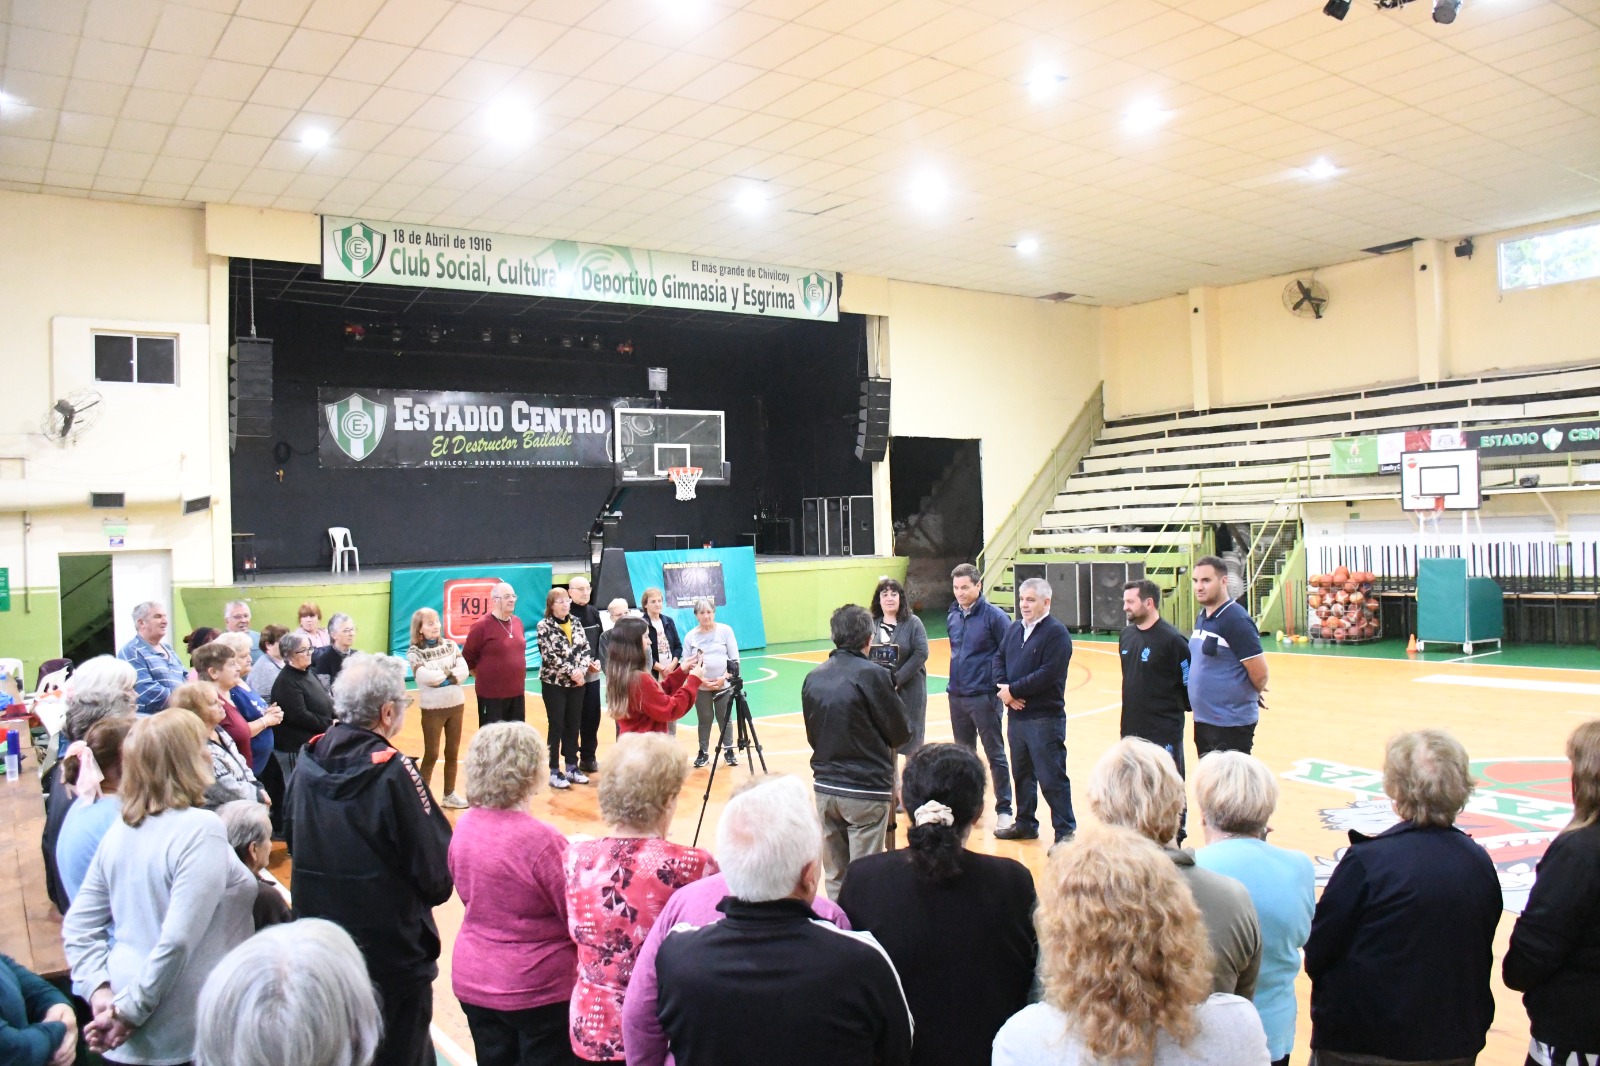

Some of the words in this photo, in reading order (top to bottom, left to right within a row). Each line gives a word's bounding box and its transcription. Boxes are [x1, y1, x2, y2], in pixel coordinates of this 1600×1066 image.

[393, 229, 405, 243] 18
[409, 231, 421, 245] de
[425, 232, 450, 248] Abril
[453, 236, 466, 249] de
[469, 237, 492, 252] 1916
[390, 247, 430, 278] Club
[436, 252, 491, 286] Social,
[582, 266, 657, 297] Deportivo
[662, 274, 727, 303] Gimnasia
[731, 286, 739, 311] y
[743, 282, 795, 313] Esgrima
[692, 260, 699, 272] El
[701, 262, 717, 274] más
[719, 265, 745, 277] grande
[747, 266, 756, 278] de
[758, 268, 790, 284] Chivilcoy
[394, 397, 503, 432] ESTADIO
[511, 401, 605, 433] CENTRO
[431, 435, 449, 458] El
[452, 435, 518, 455] Destructor
[523, 429, 572, 449] Bailable
[1480, 433, 1539, 448] ESTADIO
[461, 597, 488, 616] K9J
